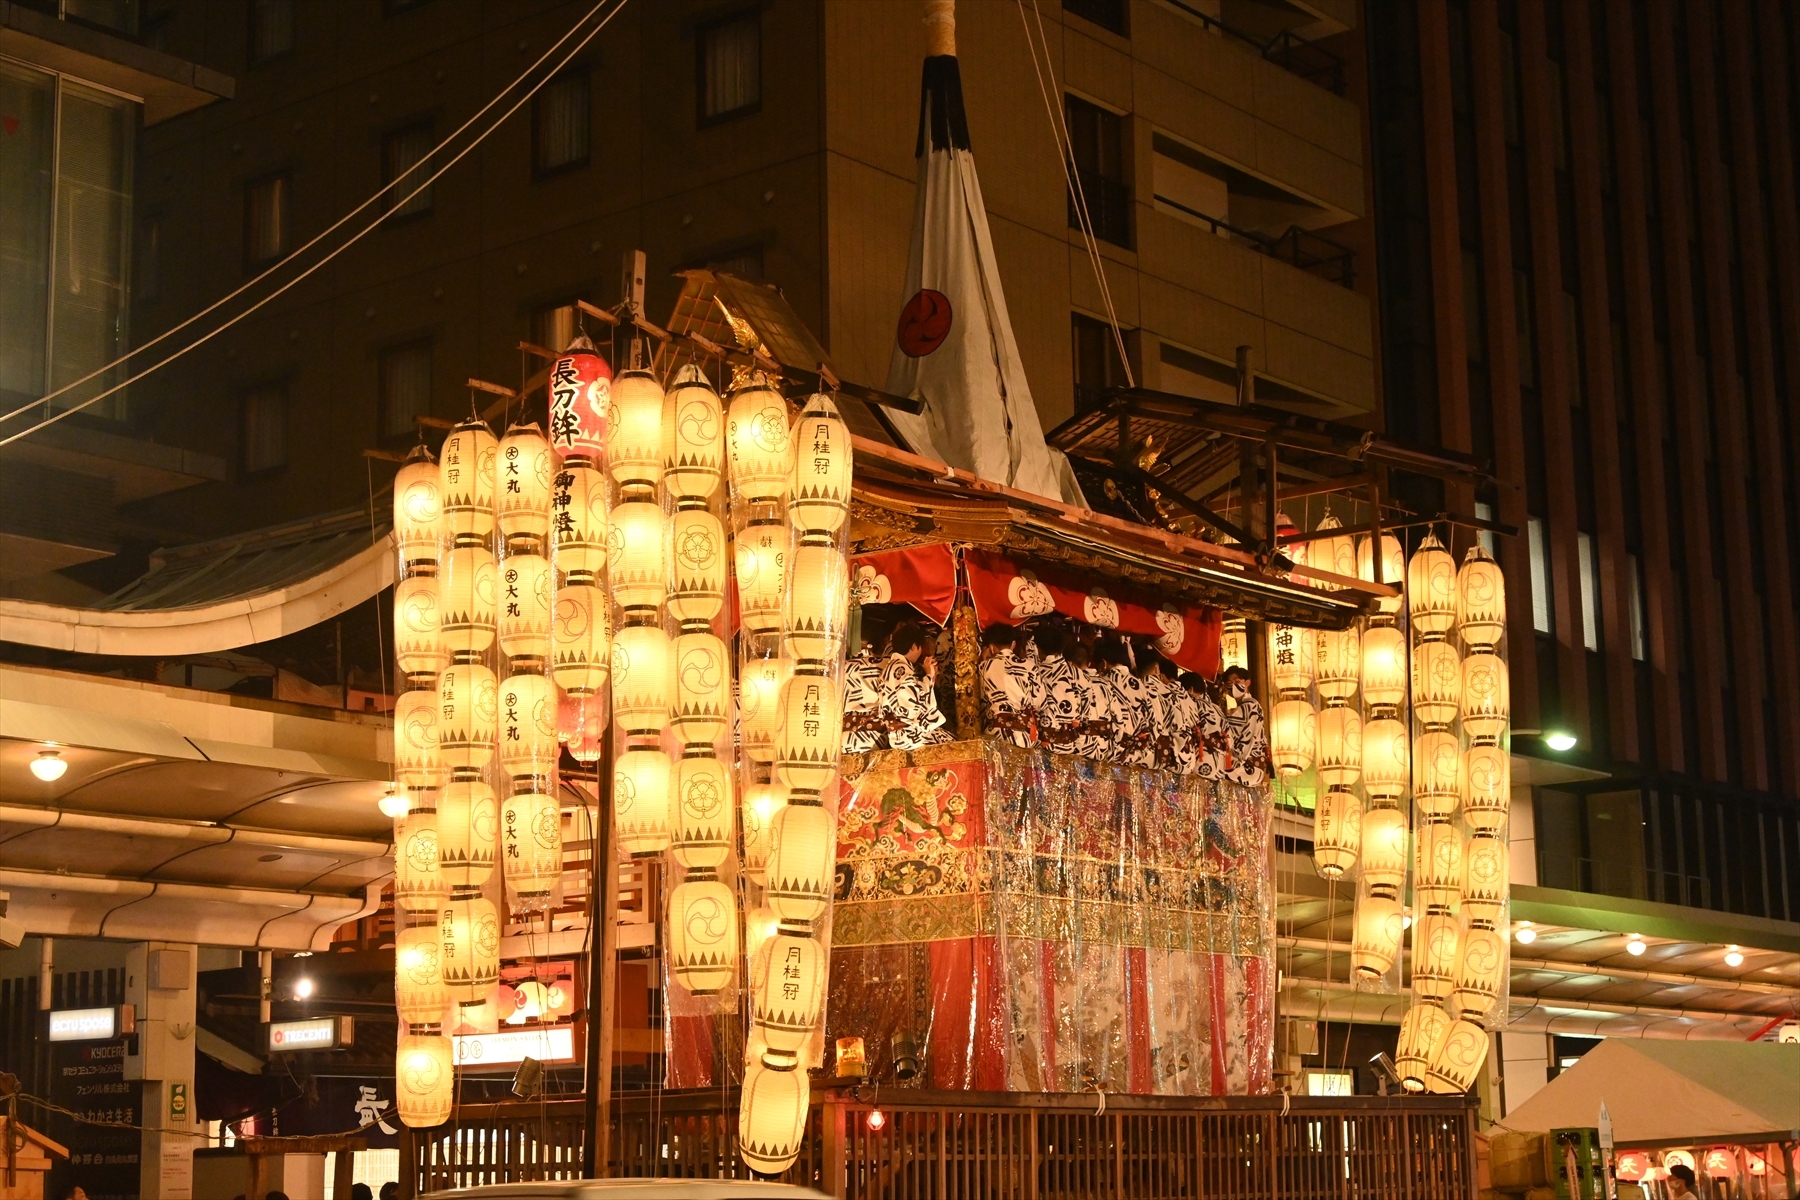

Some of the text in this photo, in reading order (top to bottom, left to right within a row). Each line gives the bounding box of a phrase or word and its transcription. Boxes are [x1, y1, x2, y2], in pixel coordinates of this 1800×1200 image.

[552, 358, 580, 447] 長刀鉾
[446, 437, 461, 485] 月桂冠
[813, 424, 831, 475] 月桂冠
[442, 673, 455, 720] 月桂冠
[803, 684, 820, 737] 月桂冠
[442, 910, 455, 958] 月桂冠
[782, 946, 801, 1001] 月桂冠
[284, 1027, 331, 1043] TRECENTI
[77, 1083, 130, 1095] フェンリル株式会社
